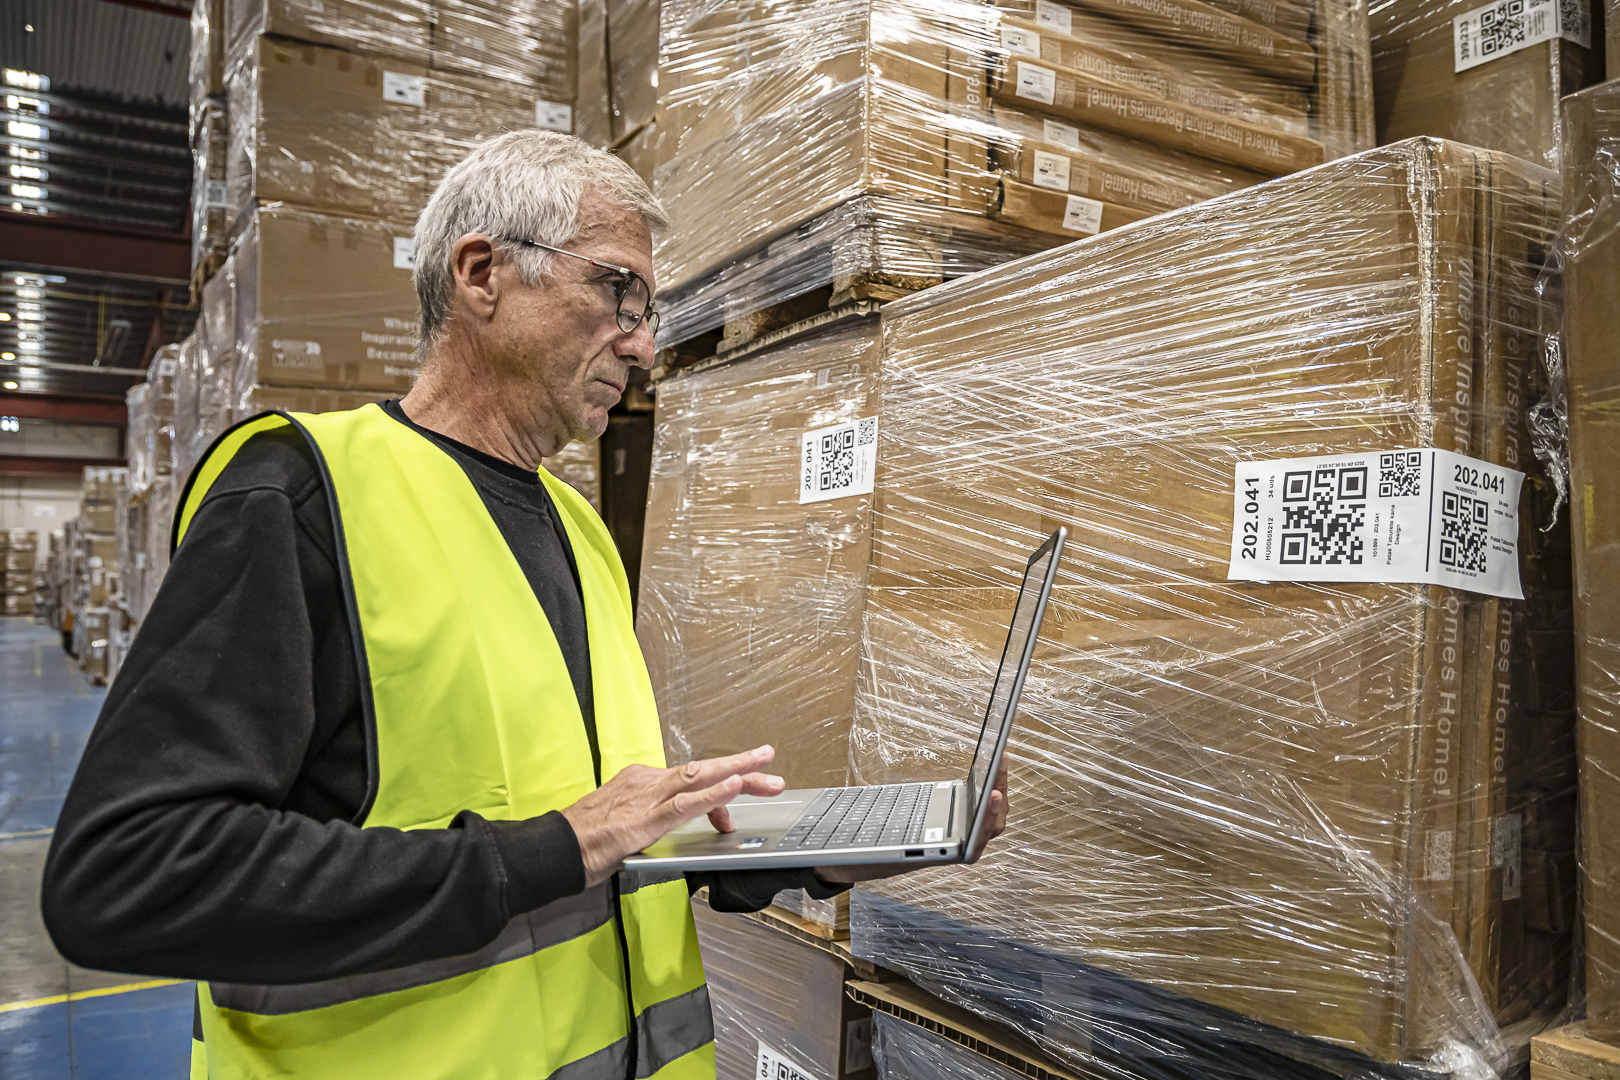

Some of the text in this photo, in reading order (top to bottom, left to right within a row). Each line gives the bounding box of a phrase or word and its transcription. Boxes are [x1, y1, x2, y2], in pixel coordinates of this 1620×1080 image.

[1072, 50, 1113, 81] Home!
[1086, 86, 1128, 117] Home!
[1129, 99, 1184, 133] Becomes
[1100, 172, 1140, 201] Home!
[1457, 255, 1474, 353] Where
[1504, 361, 1522, 466] Inspira
[804, 440, 813, 491] 202.041
[1454, 464, 1504, 495] 202.041
[1268, 490, 1275, 498] 34
[1241, 477, 1260, 560] 202.041
[1373, 512, 1381, 534] 202.041
[1394, 524, 1402, 545] Design
[1440, 594, 1460, 683] omes
[1432, 690, 1457, 797] Home!
[1492, 681, 1511, 784] Home!
